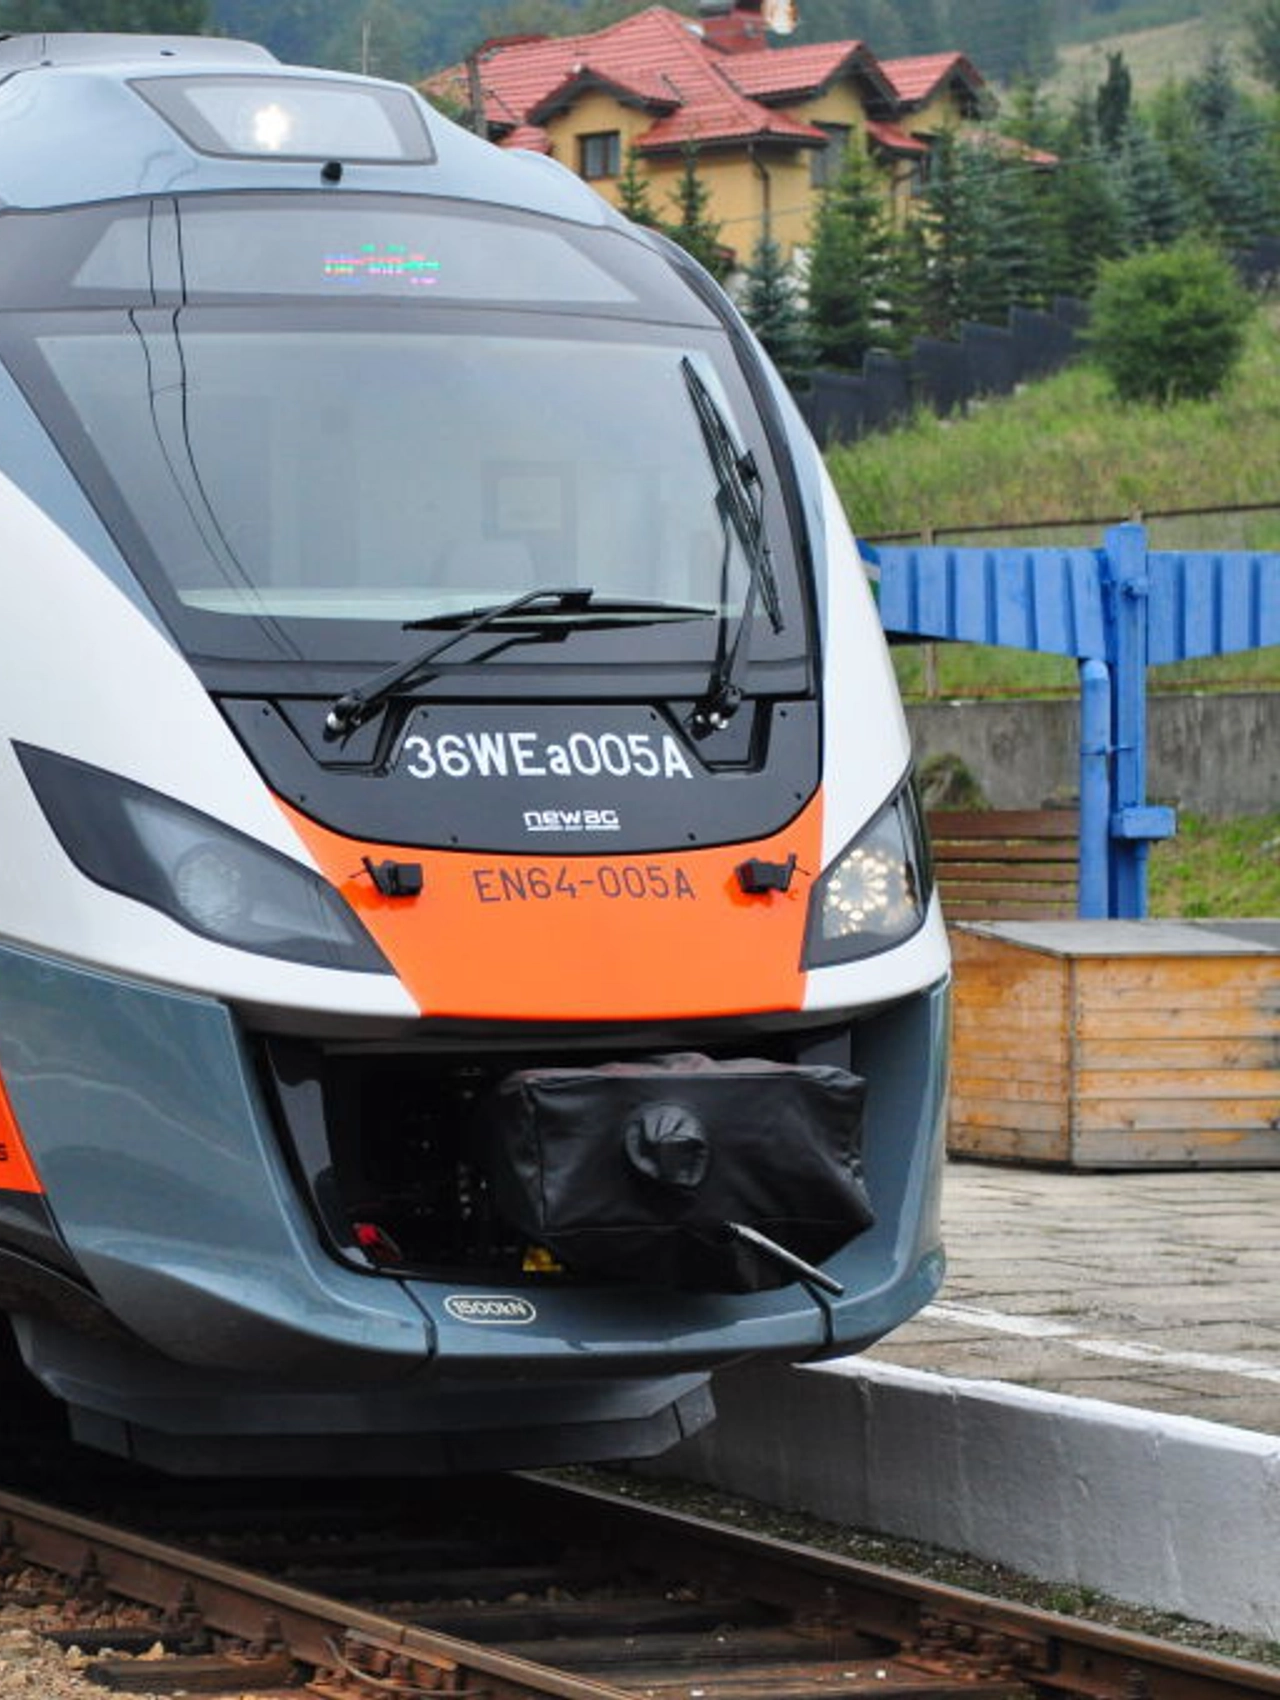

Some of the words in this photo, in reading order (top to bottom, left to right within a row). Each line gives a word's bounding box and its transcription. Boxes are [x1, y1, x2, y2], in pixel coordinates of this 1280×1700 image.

[403, 732, 693, 779] 36WEa005A
[473, 866, 696, 903] EN64-005A
[452, 1300, 527, 1316] 1500kN
